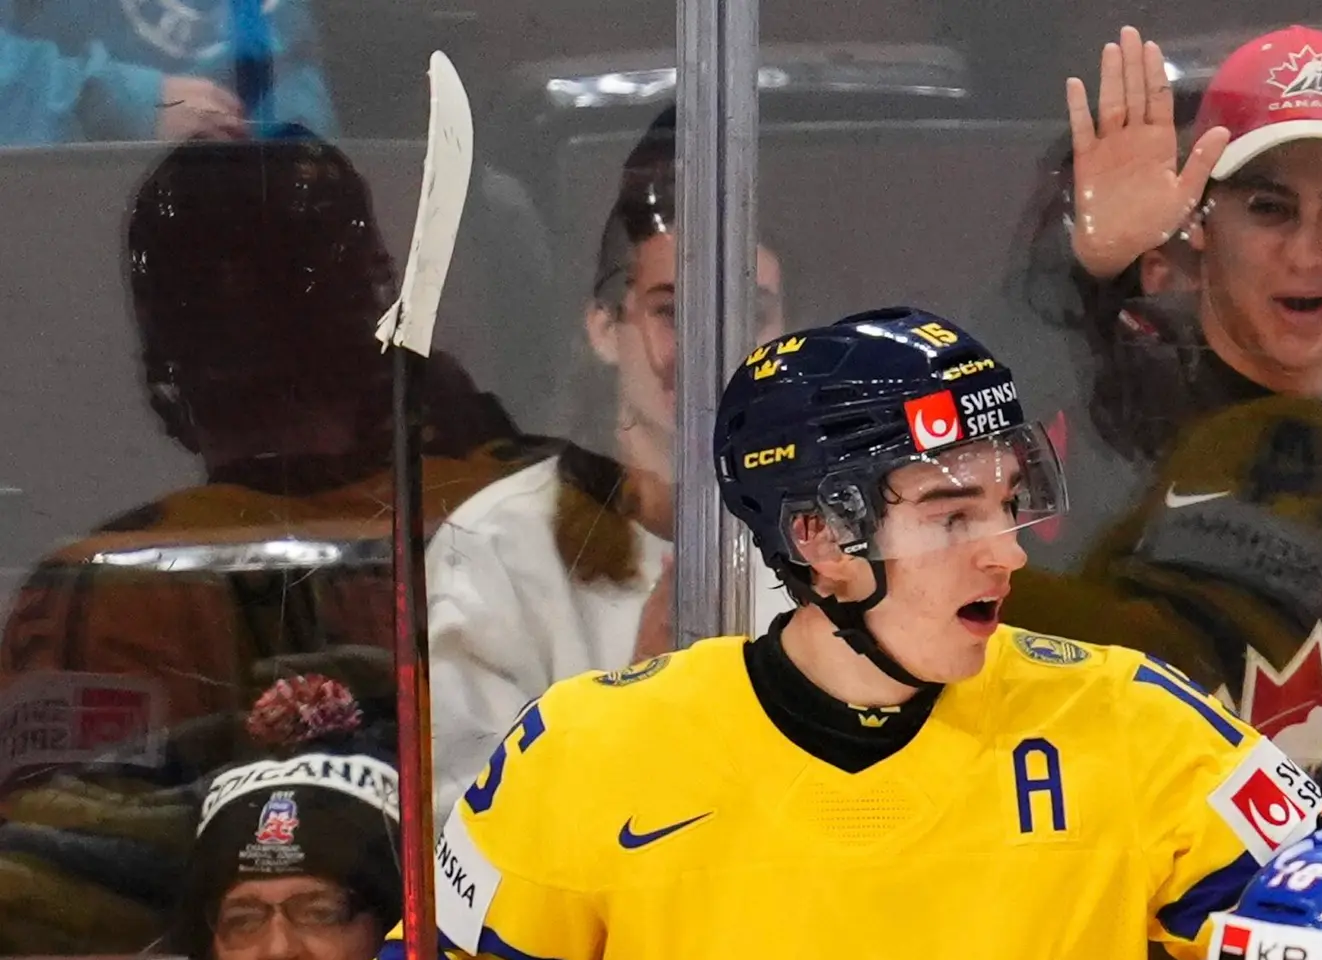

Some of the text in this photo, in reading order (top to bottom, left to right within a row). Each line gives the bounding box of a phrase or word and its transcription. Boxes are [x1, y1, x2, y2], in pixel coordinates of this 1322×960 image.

[910, 322, 959, 348] 15
[966, 408, 1011, 437] SPEL
[743, 443, 797, 470] CCM
[1012, 737, 1067, 834] A
[434, 832, 477, 909] ENSKA
